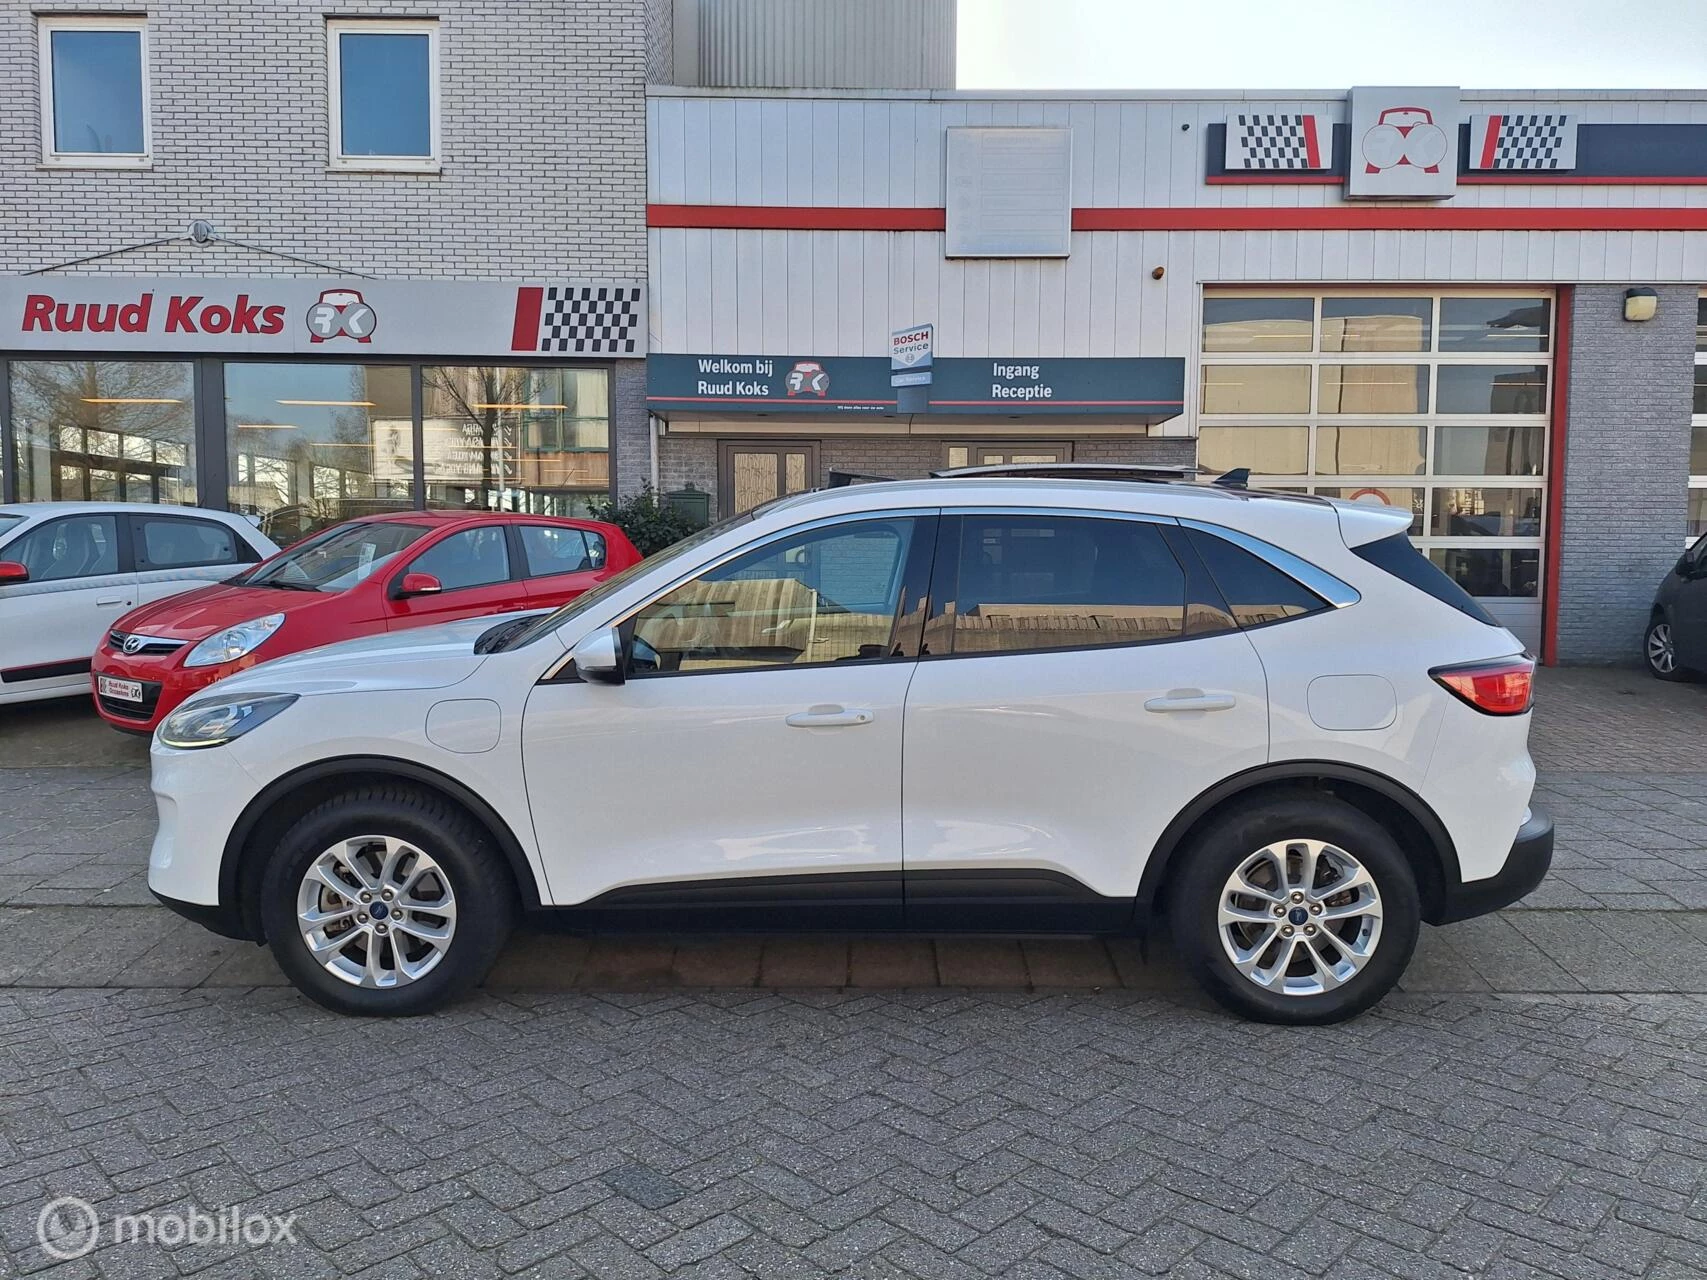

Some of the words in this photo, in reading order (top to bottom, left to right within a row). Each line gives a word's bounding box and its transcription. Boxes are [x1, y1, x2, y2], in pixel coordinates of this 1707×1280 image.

[21, 293, 153, 333] Ruud
[164, 294, 286, 335] Koks
[893, 330, 929, 347] BOSCH
[893, 342, 929, 355] Service
[698, 359, 753, 374] Welkom
[756, 360, 773, 377] bij
[993, 363, 1040, 379] Ingang
[698, 381, 733, 395] Ruud
[736, 382, 769, 396] Koks
[992, 384, 1052, 400] Receptie
